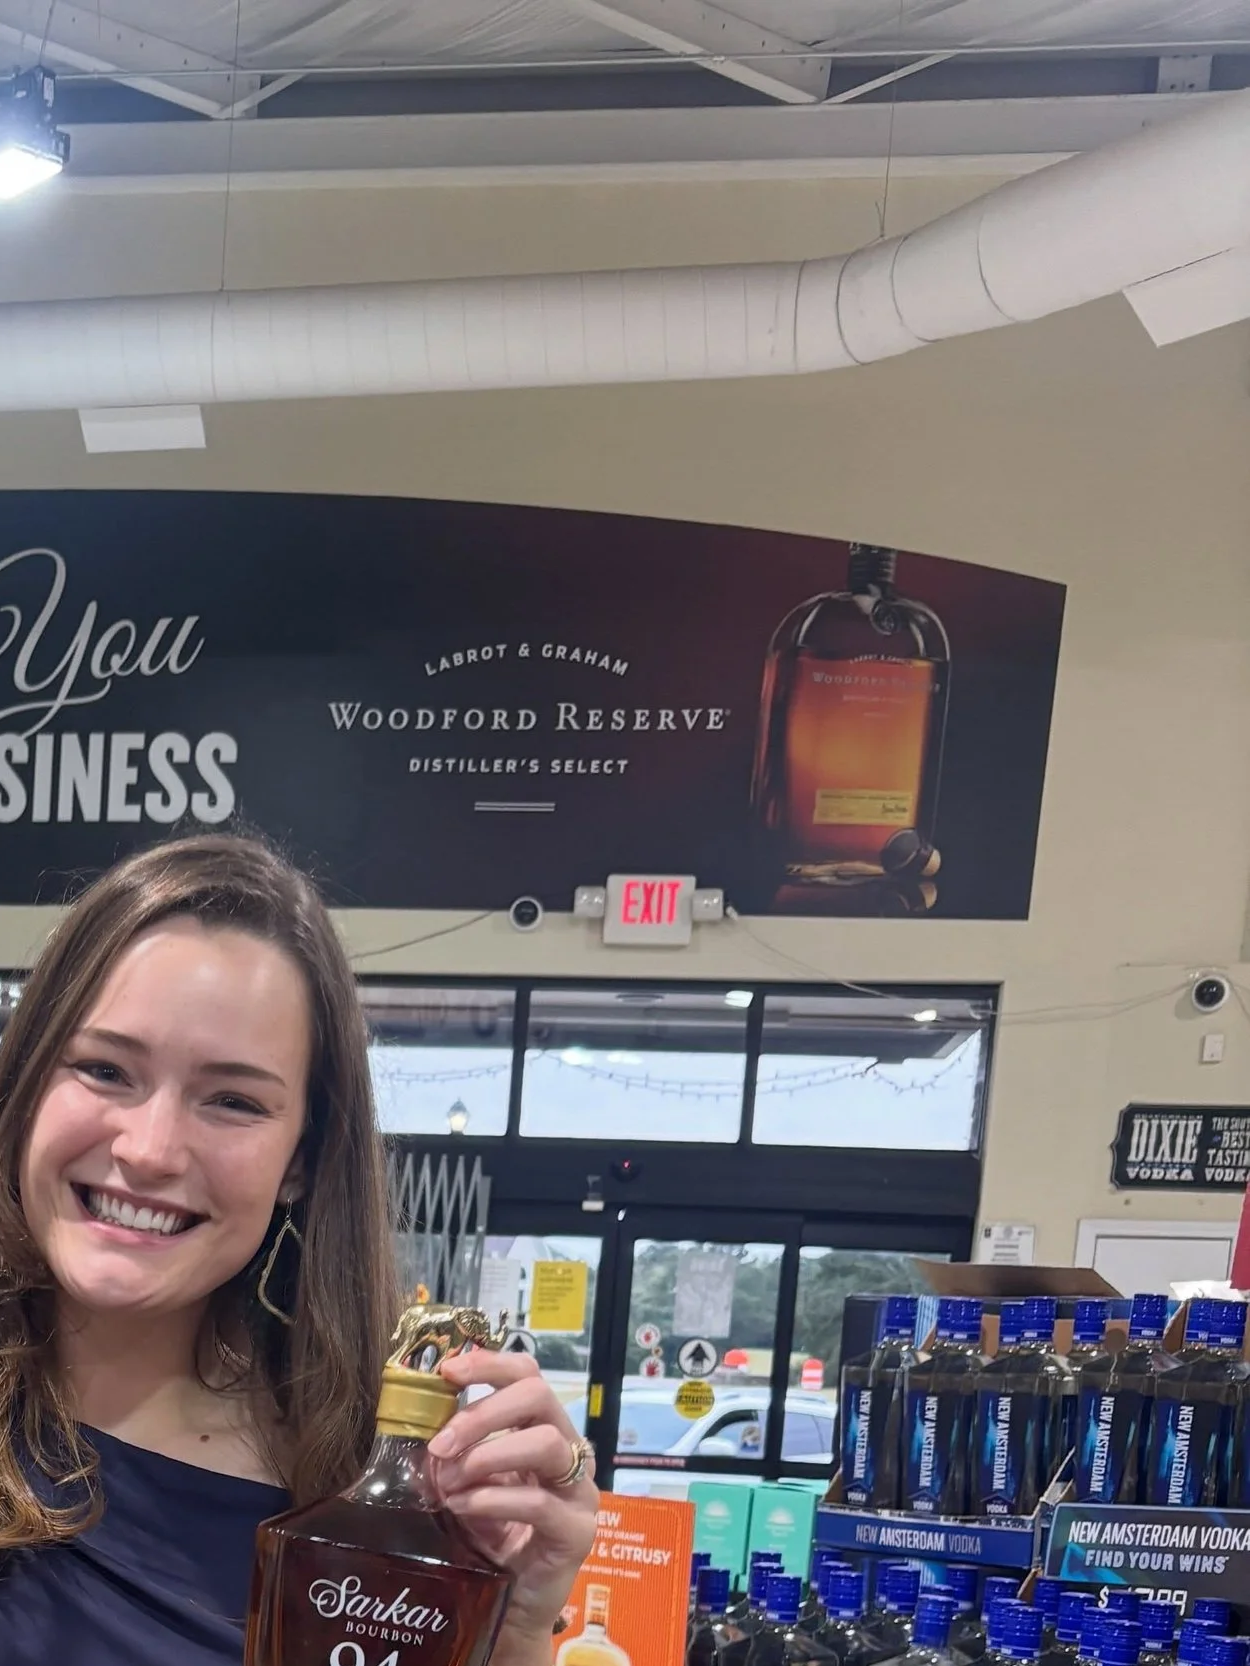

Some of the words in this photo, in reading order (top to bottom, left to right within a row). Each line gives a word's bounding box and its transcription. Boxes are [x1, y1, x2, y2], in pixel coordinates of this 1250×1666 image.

[424, 643, 508, 677] LABROT
[518, 643, 531, 658] &
[541, 643, 630, 676] GRAHAM
[328, 703, 537, 731] WOODFORD
[555, 703, 726, 732] RESERVE
[408, 757, 540, 774] DISTILLER'S
[550, 757, 629, 775] SELECT
[620, 879, 681, 926] EXIT
[1127, 1119, 1203, 1164] DIXIE
[1221, 1131, 1250, 1149] BEST
[1126, 1166, 1194, 1181] VODKA
[860, 1391, 872, 1416] NEW
[924, 1396, 938, 1420] NEW
[997, 1397, 1011, 1422] NEW
[1098, 1396, 1115, 1424] NEW
[1177, 1405, 1194, 1433] NEW
[853, 1415, 871, 1479] AMSTERDAM
[919, 1419, 937, 1487] AMSTERDAM
[993, 1421, 1010, 1490] AMSTERDAM
[1090, 1423, 1112, 1492] AMSTERDAM
[1168, 1432, 1192, 1504] AMSTERDAM
[986, 1503, 1008, 1514] VODKA
[855, 1524, 879, 1545] NEW
[878, 1526, 945, 1551] AMSTERDAM
[948, 1533, 982, 1555] VODKA
[1068, 1520, 1102, 1544] NEW
[1102, 1523, 1197, 1549] AMSTERDAM
[1200, 1527, 1250, 1551] VODKA
[598, 1542, 607, 1558] &
[611, 1543, 672, 1567] CITRUSY
[1084, 1549, 1124, 1568] FIND
[1128, 1552, 1177, 1572] YOUR
[1179, 1554, 1227, 1575] WINS
[308, 1575, 450, 1635] Sarkar
[1098, 1585, 1109, 1608] $
[345, 1621, 424, 1646] BOURBON
